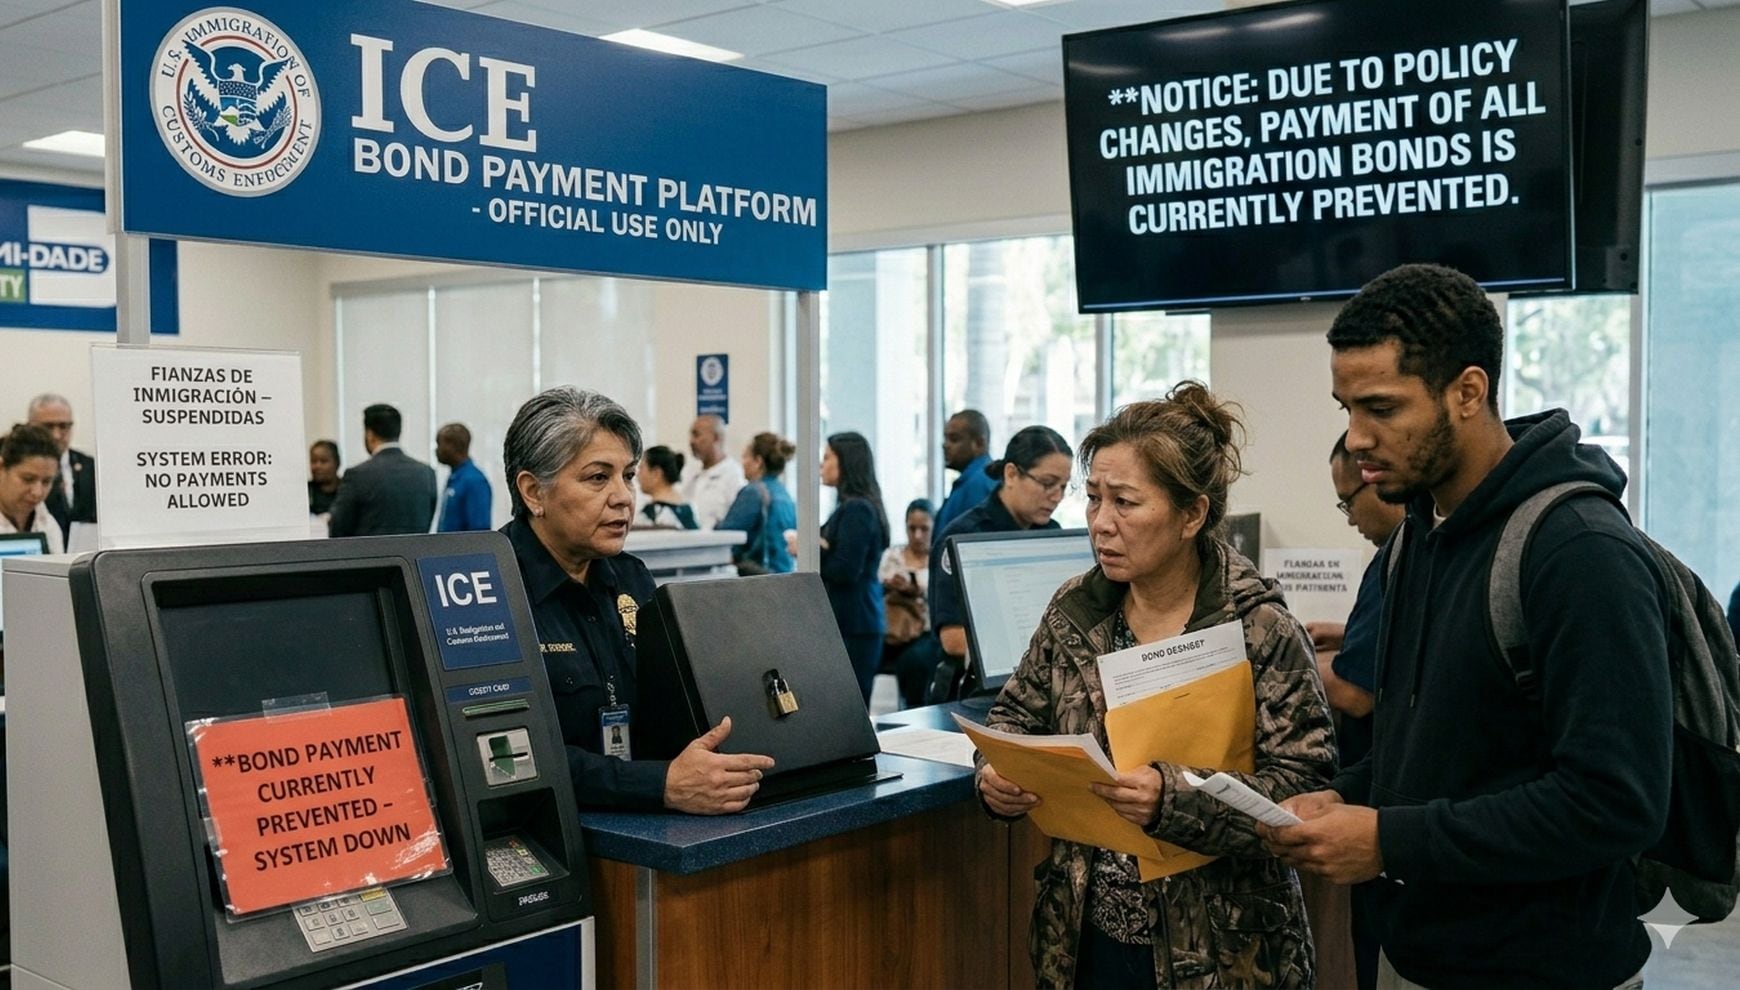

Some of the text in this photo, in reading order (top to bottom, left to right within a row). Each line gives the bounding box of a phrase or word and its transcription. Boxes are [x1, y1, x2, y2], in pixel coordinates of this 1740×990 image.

[294, 74, 311, 98] OF
[1268, 64, 1333, 100] DUE
[1339, 57, 1385, 92] TO
[1394, 39, 1519, 85] POLICY
[350, 33, 537, 153] ICE
[1099, 81, 1546, 160] CHANGES, PAYMENT OF ALL
[162, 105, 226, 183] CUSTOMS
[1126, 129, 1516, 197] IMMIGRATION BONDS IS
[353, 137, 817, 228] BOND PAYMENT PLATFORM
[488, 198, 604, 234] OFFICIAL
[612, 213, 658, 239] USE
[665, 217, 723, 246] ONLY
[1128, 174, 1520, 236] CURRENTLY PREVENTED.
[151, 366, 253, 384] FIANZAS DE
[133, 387, 257, 404] INMIGRACIÓN
[142, 409, 265, 425] SUSPENDIDAS
[136, 451, 272, 467] SYSTEM ERROR:
[145, 471, 268, 488] NO PAYMENTS
[167, 492, 250, 509] ALLOWED
[435, 571, 497, 608] ICE
[305, 730, 402, 763] PAYMENT
[257, 766, 376, 803] CURRENTLY
[256, 797, 377, 836] PREVENTED
[254, 822, 411, 872] SYSTEM DOWN
